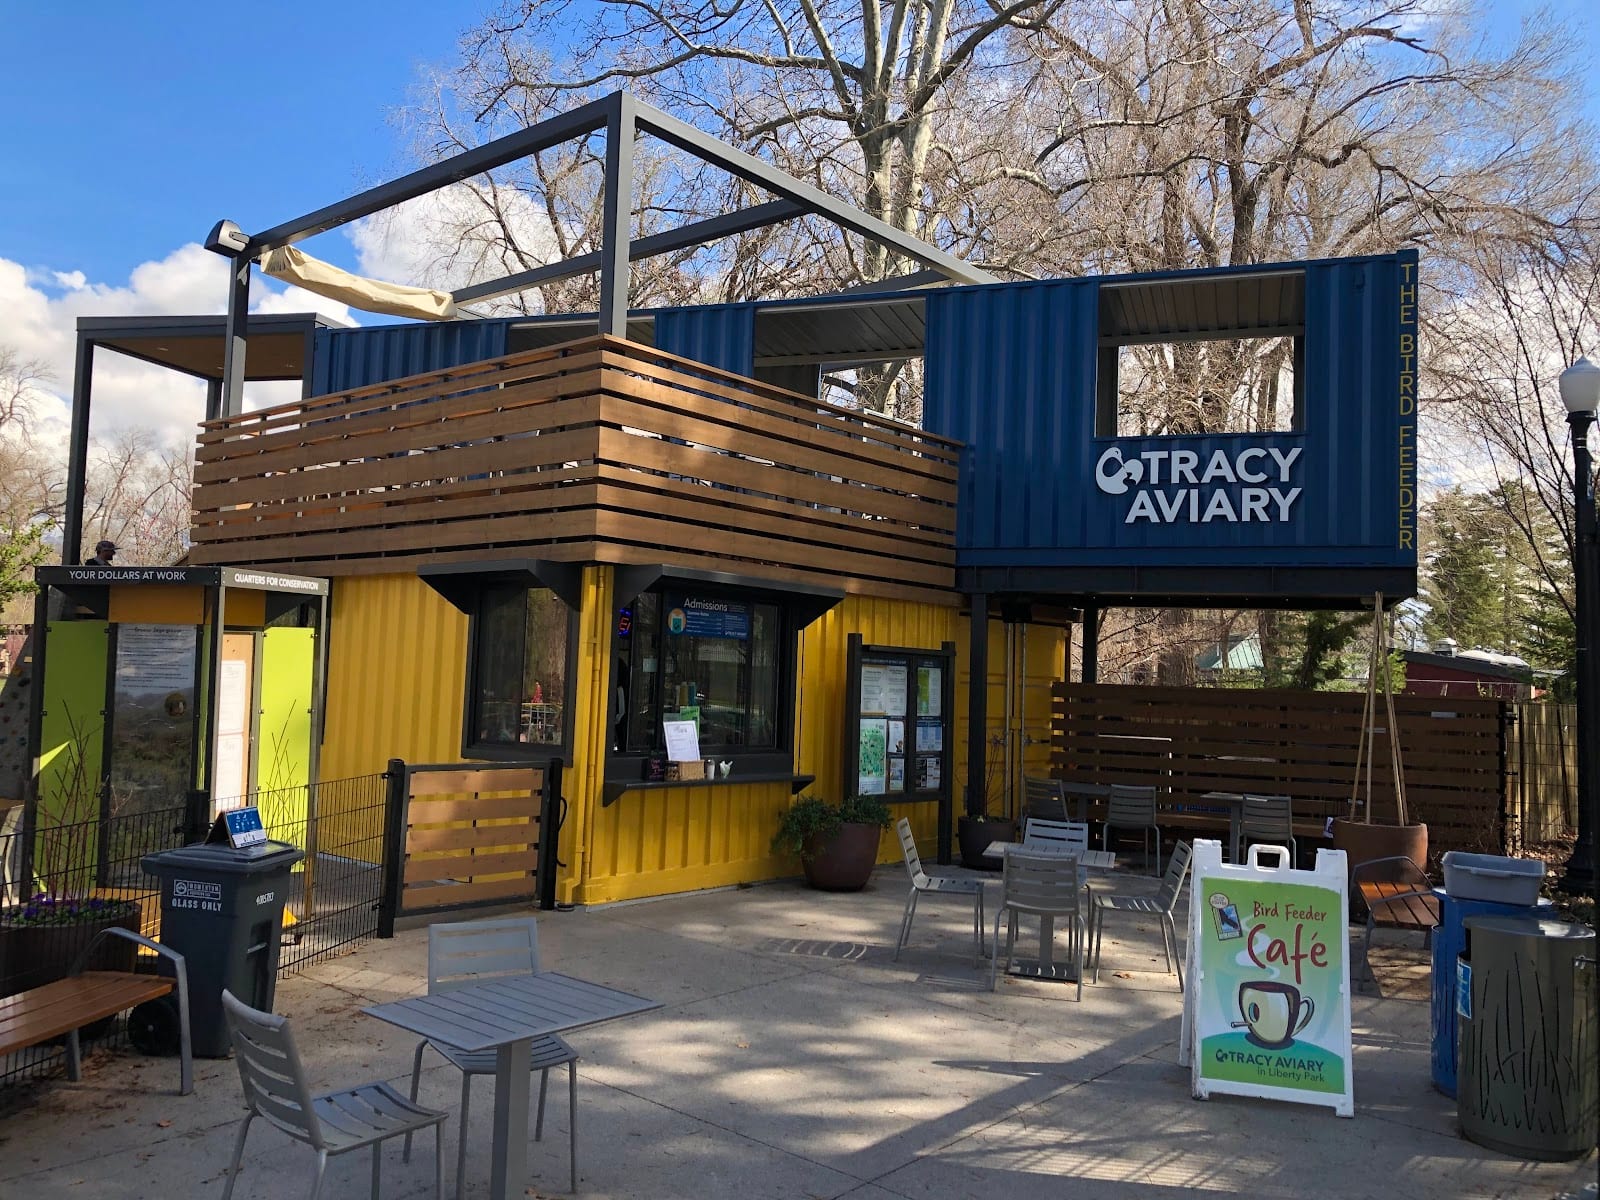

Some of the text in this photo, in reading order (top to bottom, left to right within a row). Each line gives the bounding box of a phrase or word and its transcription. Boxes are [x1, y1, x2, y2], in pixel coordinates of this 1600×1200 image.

[1399, 263, 1415, 550] THE BIRD FEEDER
[1141, 447, 1303, 485] TRACY
[1125, 487, 1303, 524] AVIARY
[69, 570, 186, 581] YOUR DOLLARS AT WORK
[234, 573, 319, 591] QUARTERS FOR CONSERVATION
[683, 598, 728, 612] Admissions
[172, 898, 222, 912] GLASS ONLY
[1253, 901, 1327, 921] Bird Feeder
[1247, 923, 1328, 985] Café
[1228, 1051, 1324, 1072] TRACY AVIARY
[1268, 1068, 1301, 1082] Liberty
[1304, 1071, 1325, 1082] Park
